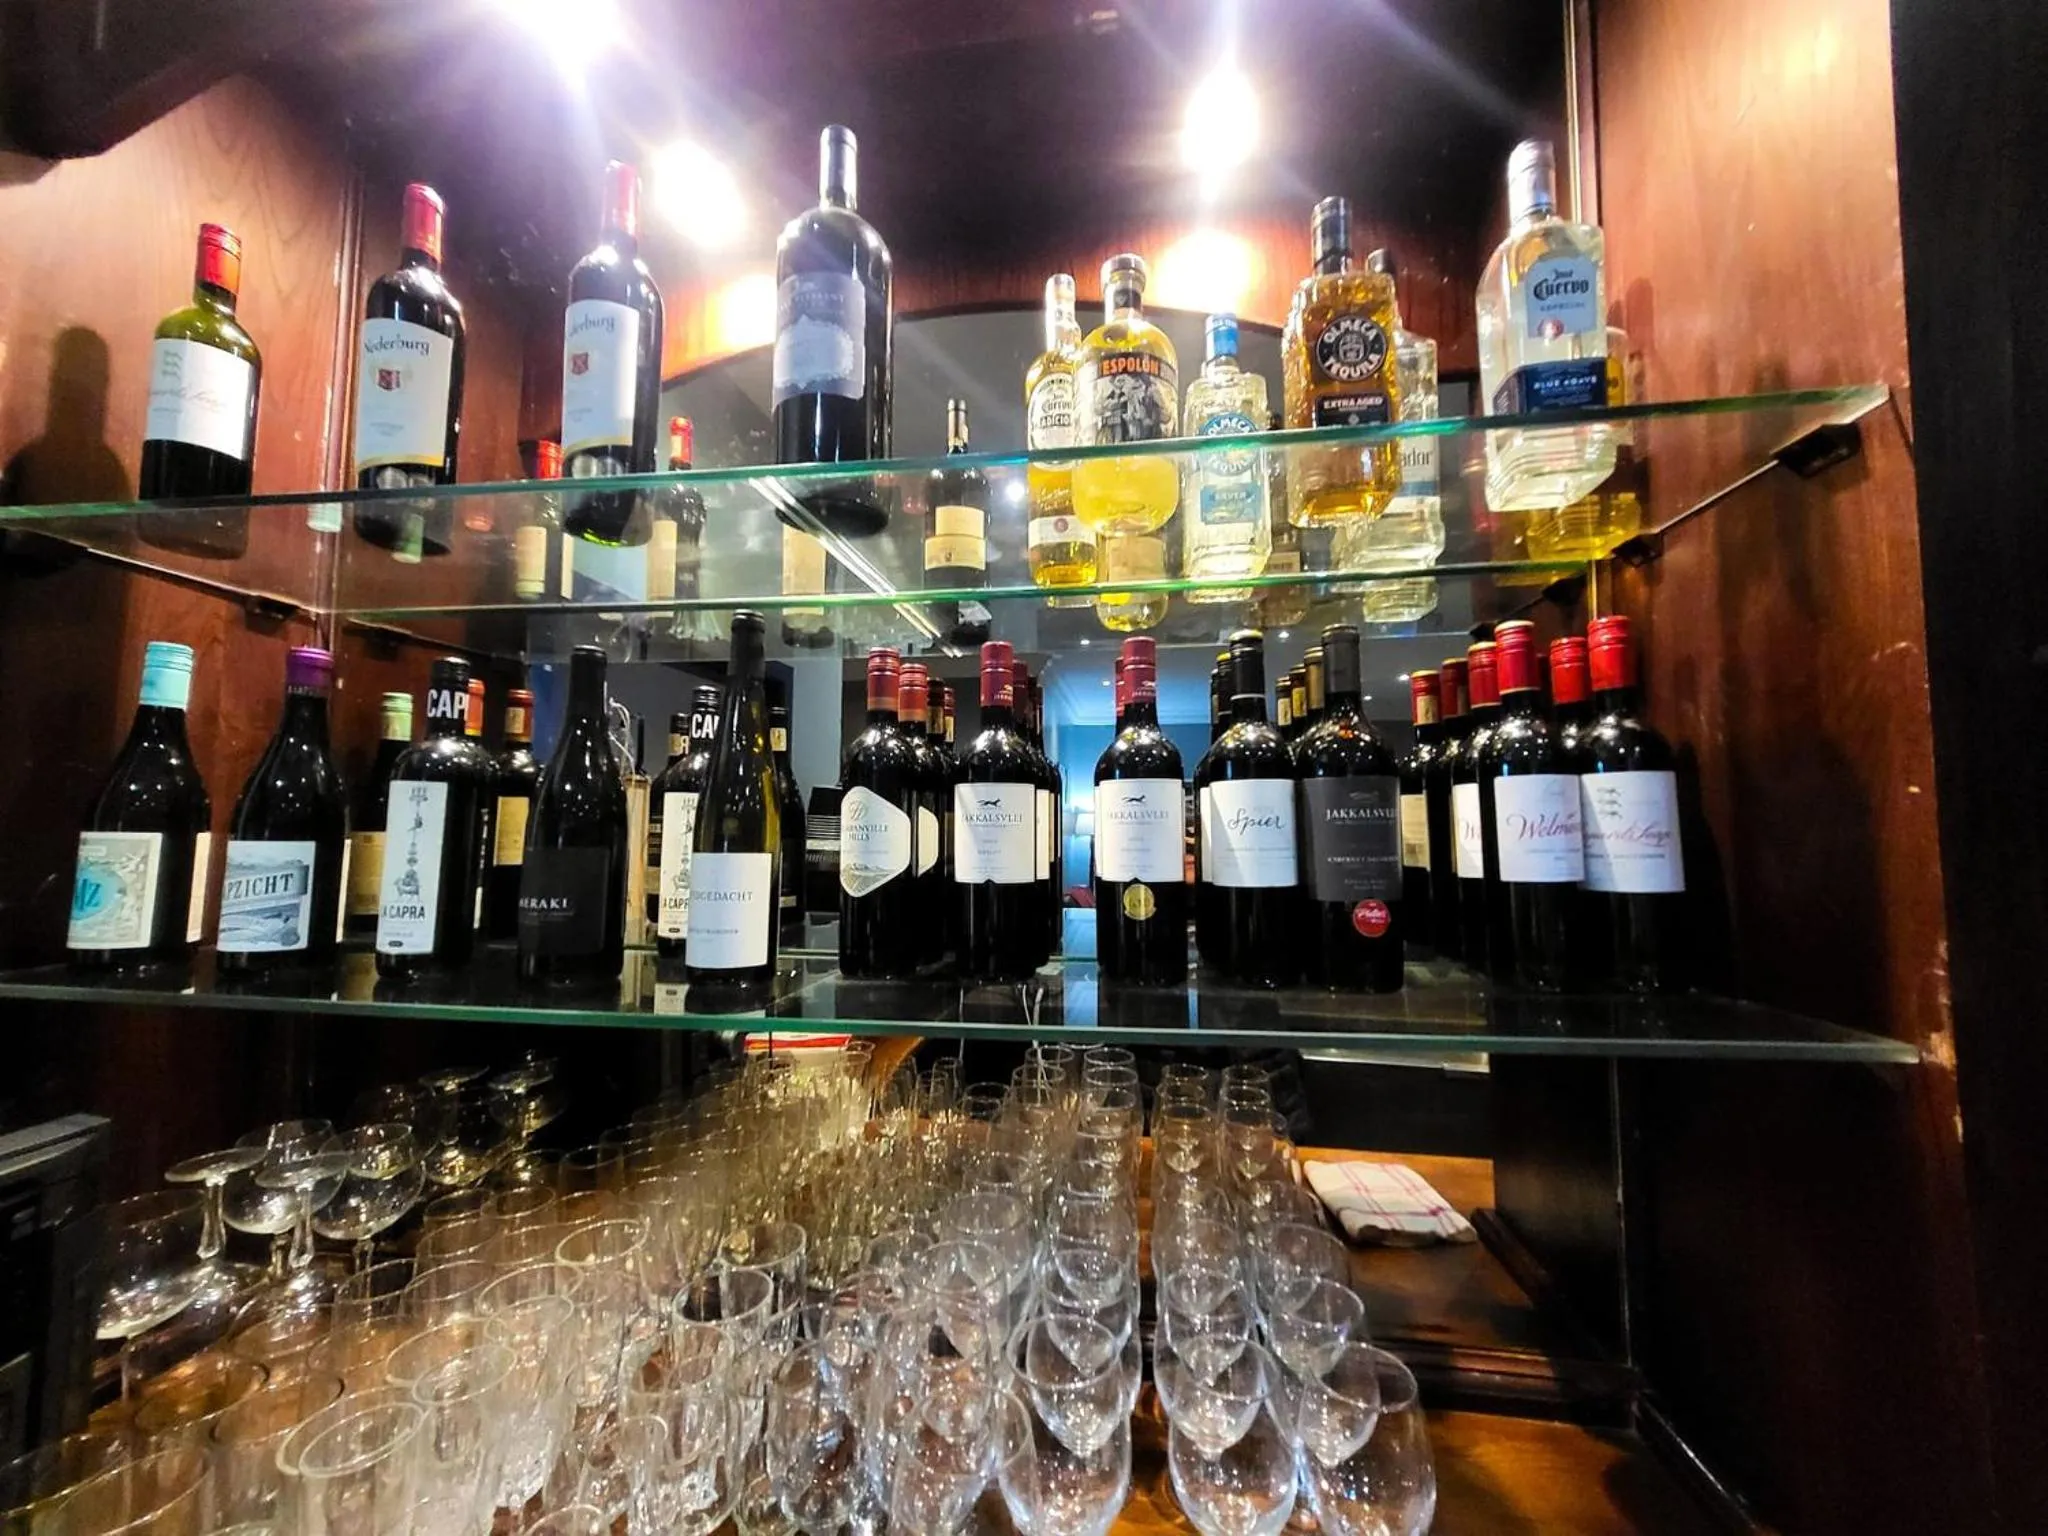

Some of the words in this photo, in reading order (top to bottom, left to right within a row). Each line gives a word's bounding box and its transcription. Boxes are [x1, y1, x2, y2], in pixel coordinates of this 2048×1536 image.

[1533, 279, 1589, 301] Cuervo
[1323, 319, 1376, 343] OLMECA
[1323, 353, 1380, 377] TEQUILA
[1323, 399, 1355, 409] EXTRA
[1356, 396, 1383, 406] AGED
[1228, 807, 1285, 836] Spier
[389, 905, 425, 919] CAPRA
